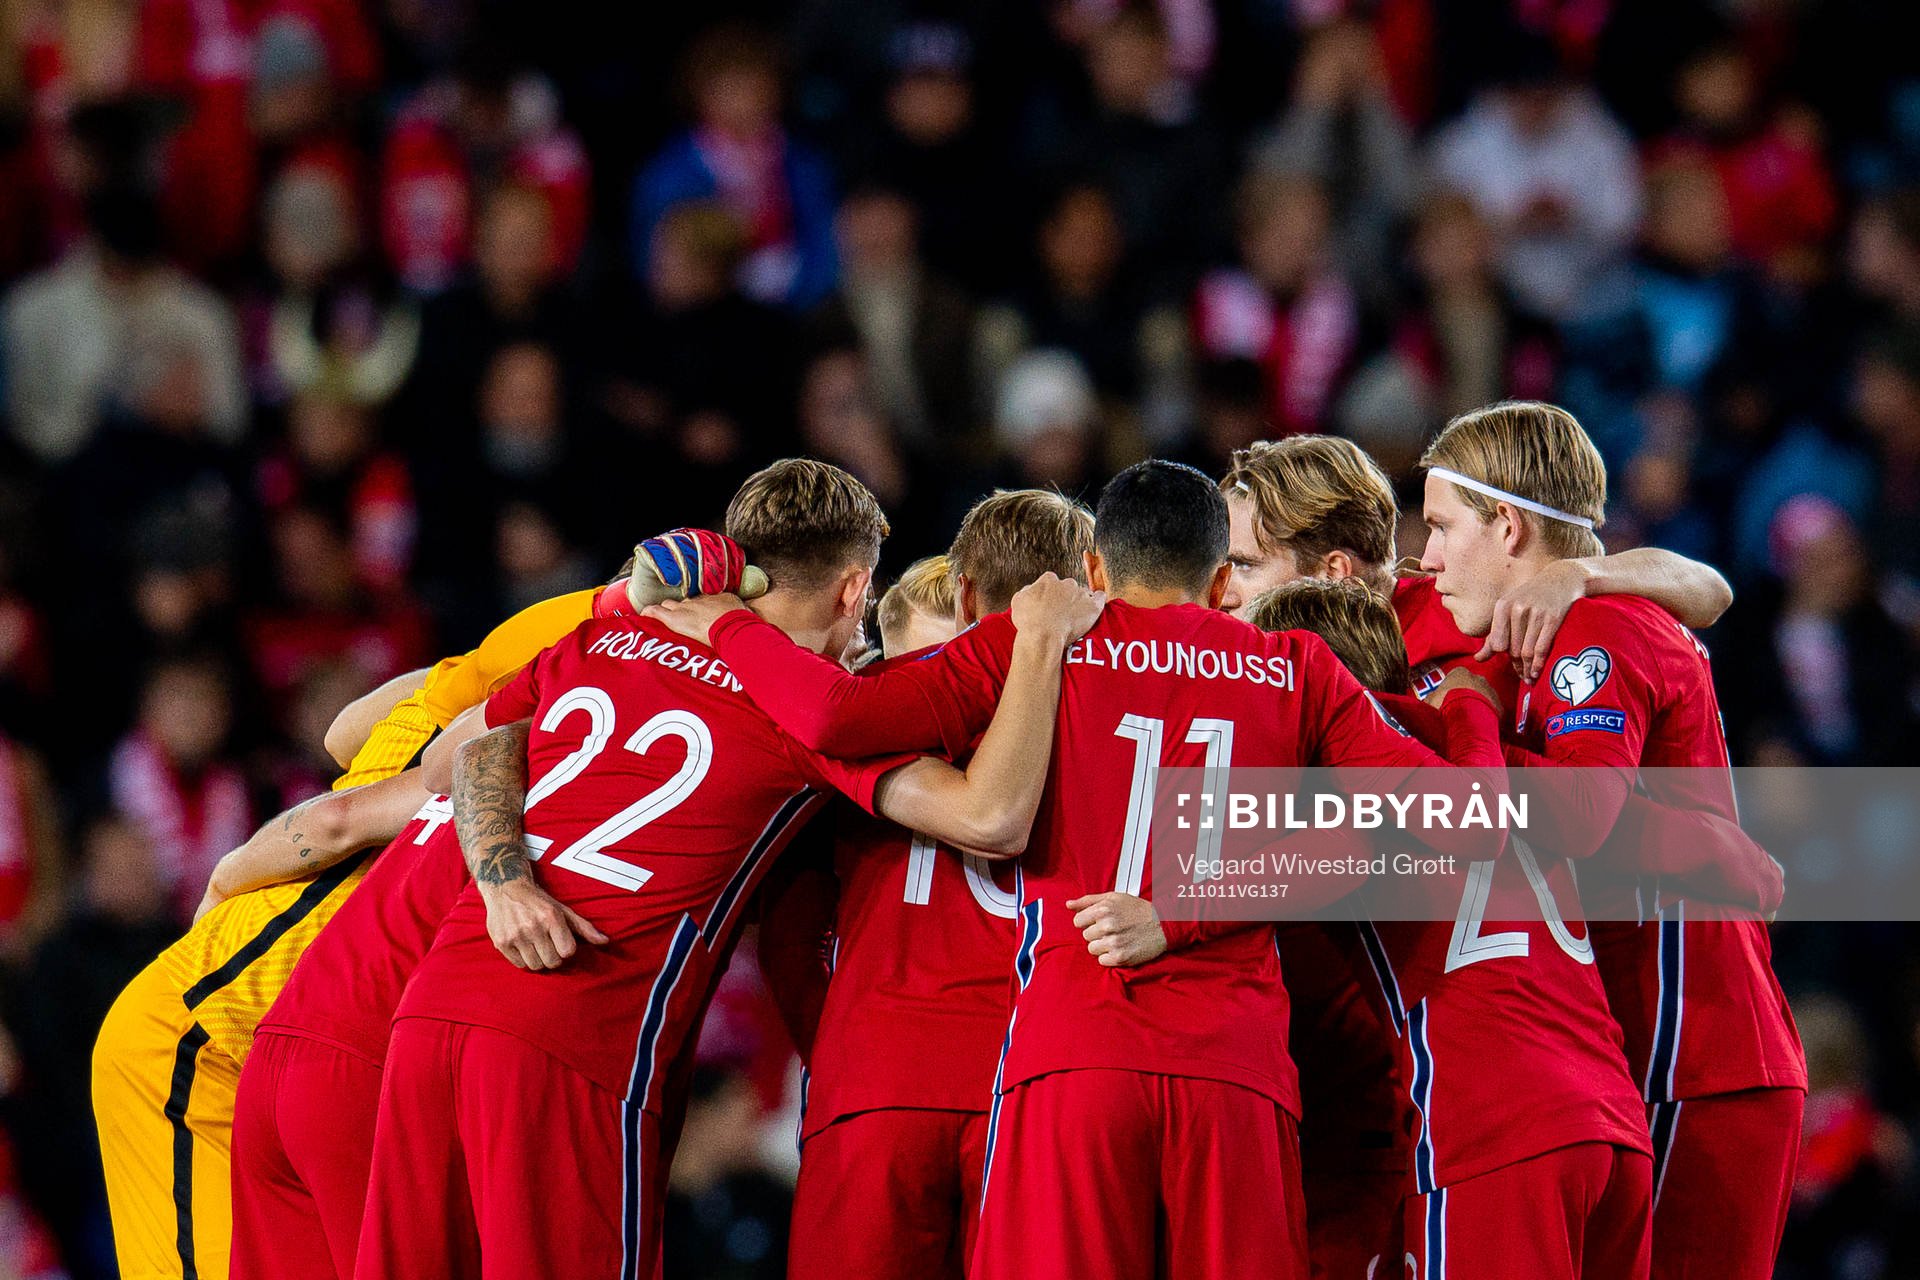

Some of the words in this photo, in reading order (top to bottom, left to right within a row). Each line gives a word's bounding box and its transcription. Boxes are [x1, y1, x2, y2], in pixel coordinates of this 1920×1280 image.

[1066, 638, 1295, 692] ELYOUNOUSSI
[1566, 714, 1624, 728] RESPECT
[523, 686, 713, 892] 22
[1114, 712, 1235, 897] 11
